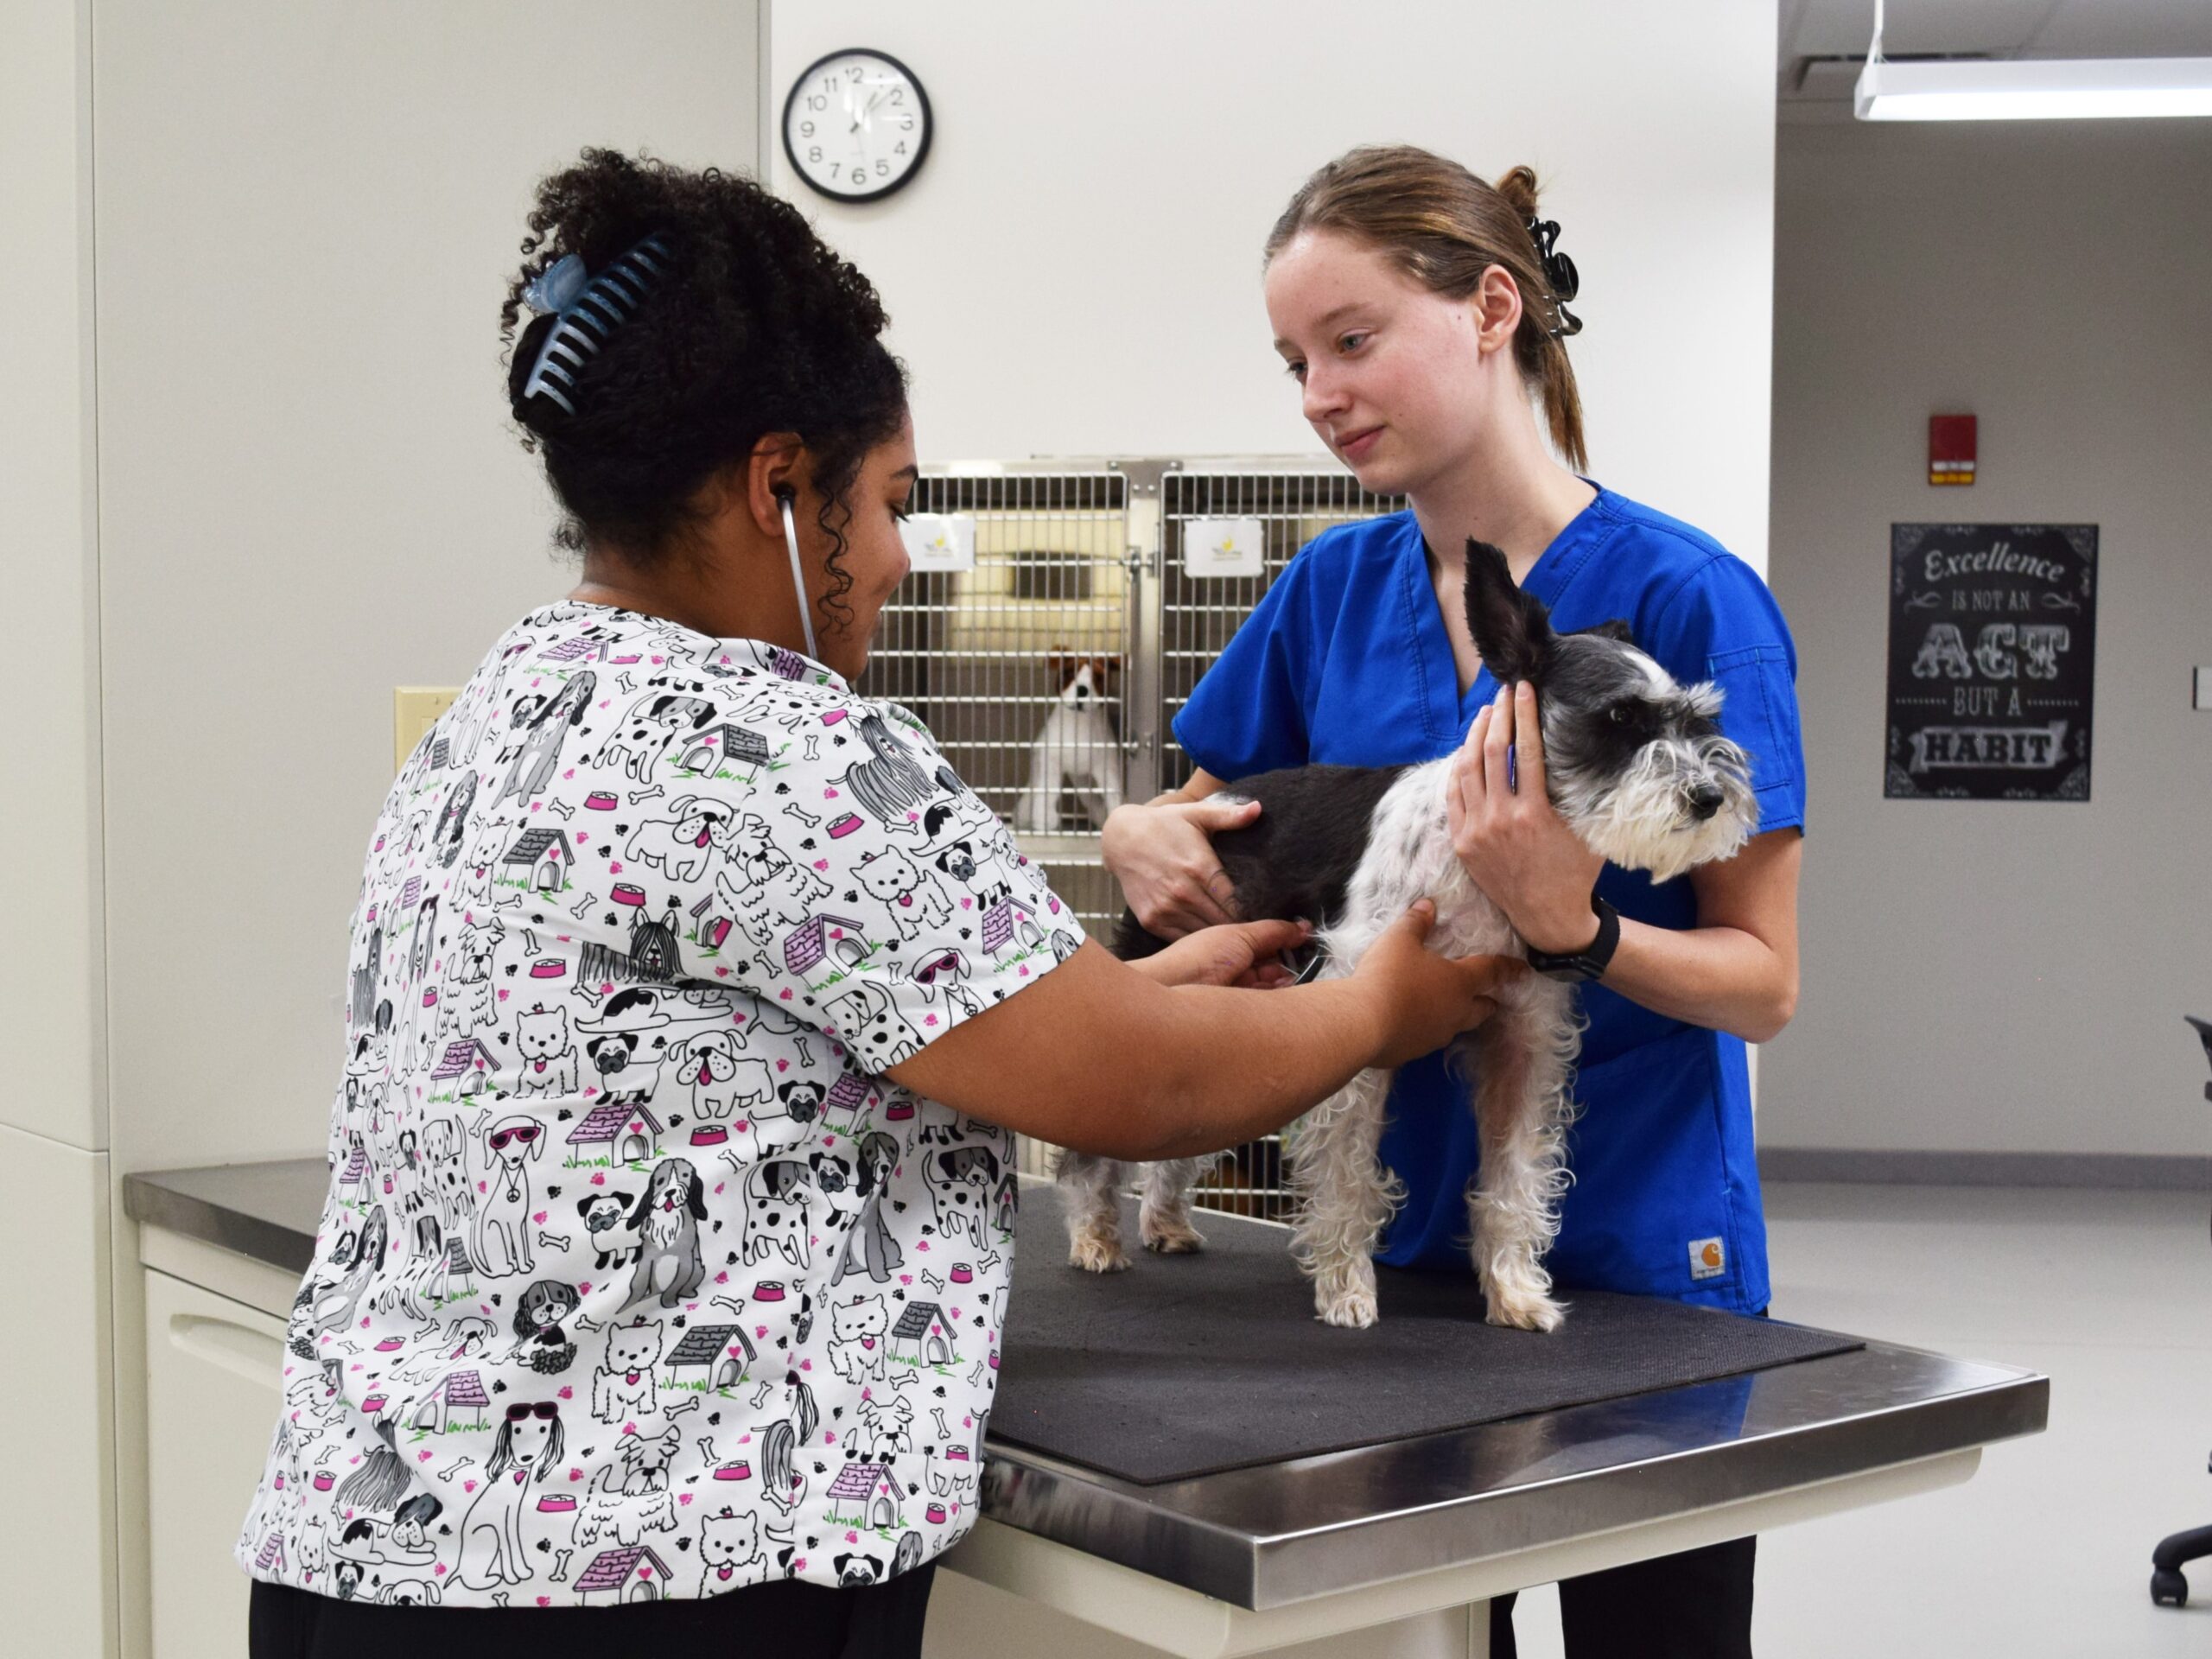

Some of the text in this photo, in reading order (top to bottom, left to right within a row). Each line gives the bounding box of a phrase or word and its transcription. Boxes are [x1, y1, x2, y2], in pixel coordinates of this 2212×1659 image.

[824, 77, 837, 92] 11
[807, 94, 827, 111] 10
[890, 88, 903, 105] 2
[800, 121, 815, 137] 9
[899, 113, 913, 130] 3
[809, 146, 822, 162] 8
[894, 140, 906, 155] 4
[830, 162, 841, 178] 7
[852, 168, 867, 184] 6
[875, 159, 889, 176] 5
[1924, 542, 2065, 582] Excellence
[1952, 590, 2031, 611] IS NOT AN
[1911, 623, 2070, 679] ACT
[1954, 687, 2023, 715] BUT A
[1923, 734, 2052, 763] HABIT
